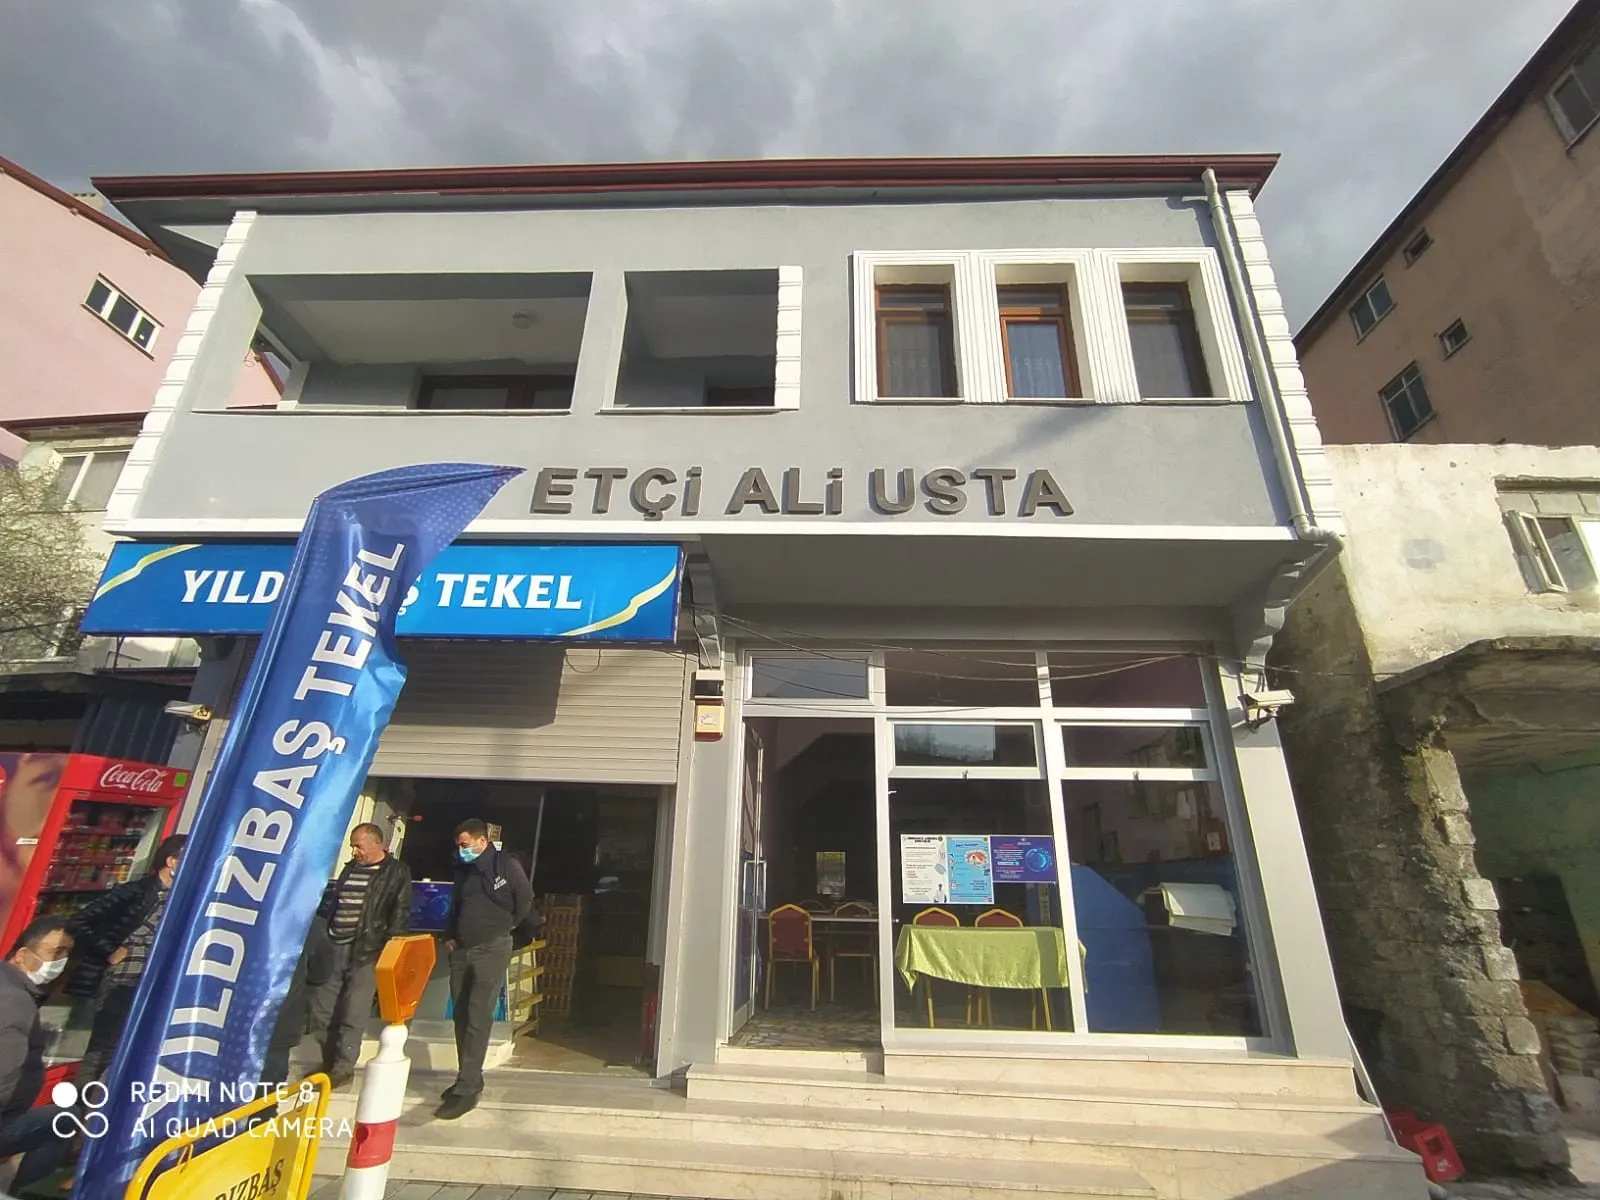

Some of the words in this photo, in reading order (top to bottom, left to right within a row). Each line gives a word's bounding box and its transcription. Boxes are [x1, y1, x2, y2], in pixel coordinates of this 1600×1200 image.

[868, 468, 1074, 517] USTA
[435, 572, 583, 610] TEKEL
[140, 719, 346, 1123] YILDIZBAŞ
[293, 543, 405, 700] TEKEL
[215, 1157, 285, 1200] IZBAŞ
